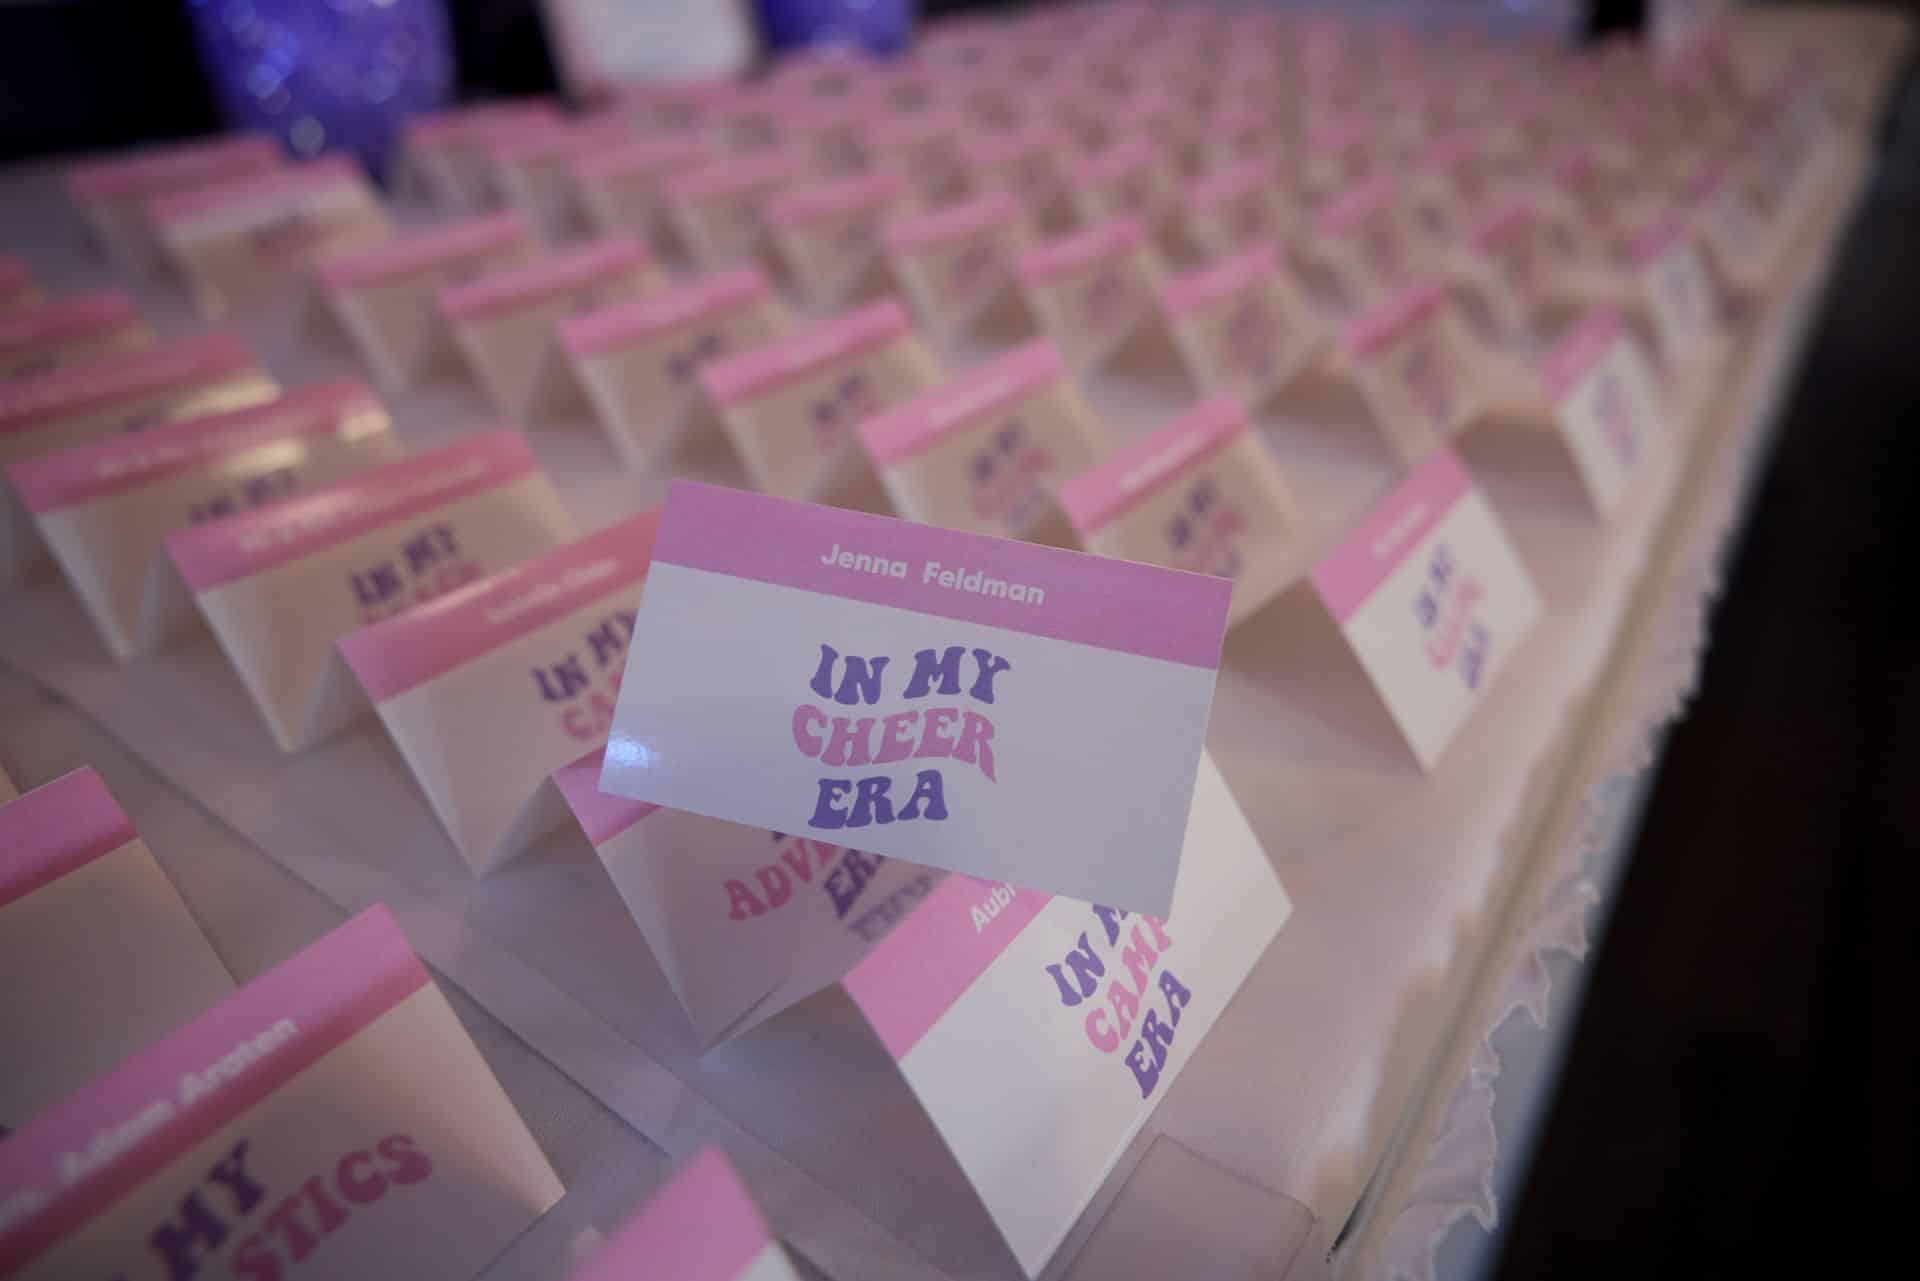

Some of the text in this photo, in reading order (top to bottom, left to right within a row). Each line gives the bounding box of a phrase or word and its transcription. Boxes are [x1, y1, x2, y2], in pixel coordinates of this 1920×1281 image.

[820, 543, 1046, 606] Jenna Feldman
[531, 659, 591, 703] IN
[809, 643, 1012, 706] IN MY
[791, 703, 997, 784] CHEER
[807, 768, 949, 830] ERA
[823, 850, 886, 920] ER
[1046, 930, 1105, 1007] IN
[1124, 968, 1192, 1100] ERA
